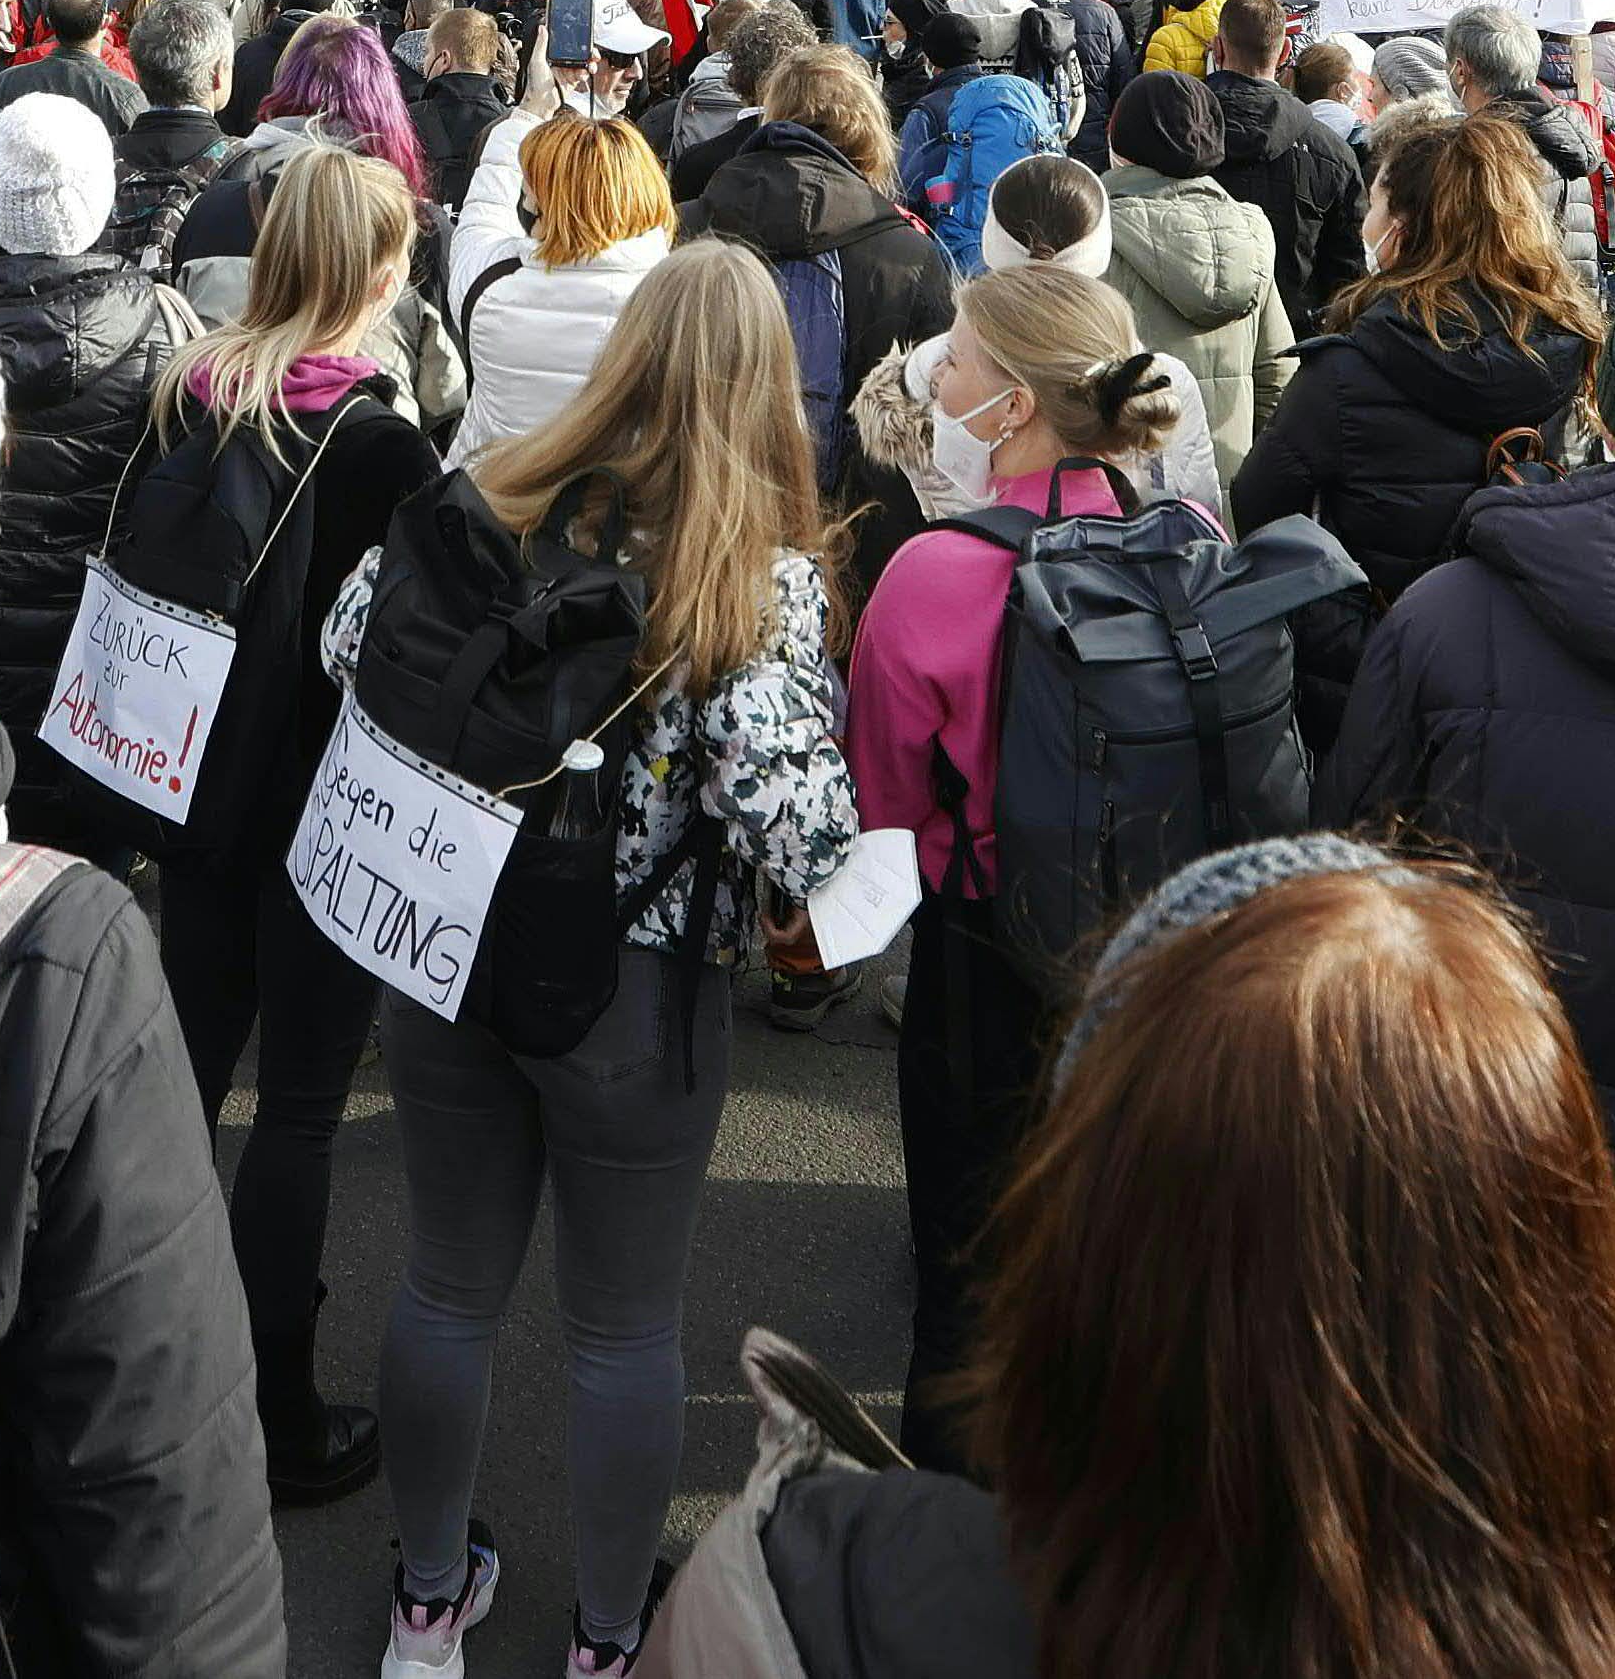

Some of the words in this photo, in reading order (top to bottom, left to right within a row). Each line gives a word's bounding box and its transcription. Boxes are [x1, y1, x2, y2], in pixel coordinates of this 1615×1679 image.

[88, 590, 190, 680] ZURÜCK
[49, 669, 199, 795] Autonomie!
[321, 715, 395, 833] Gegen
[408, 807, 458, 874] die
[294, 792, 473, 1006] SPALTUNG
